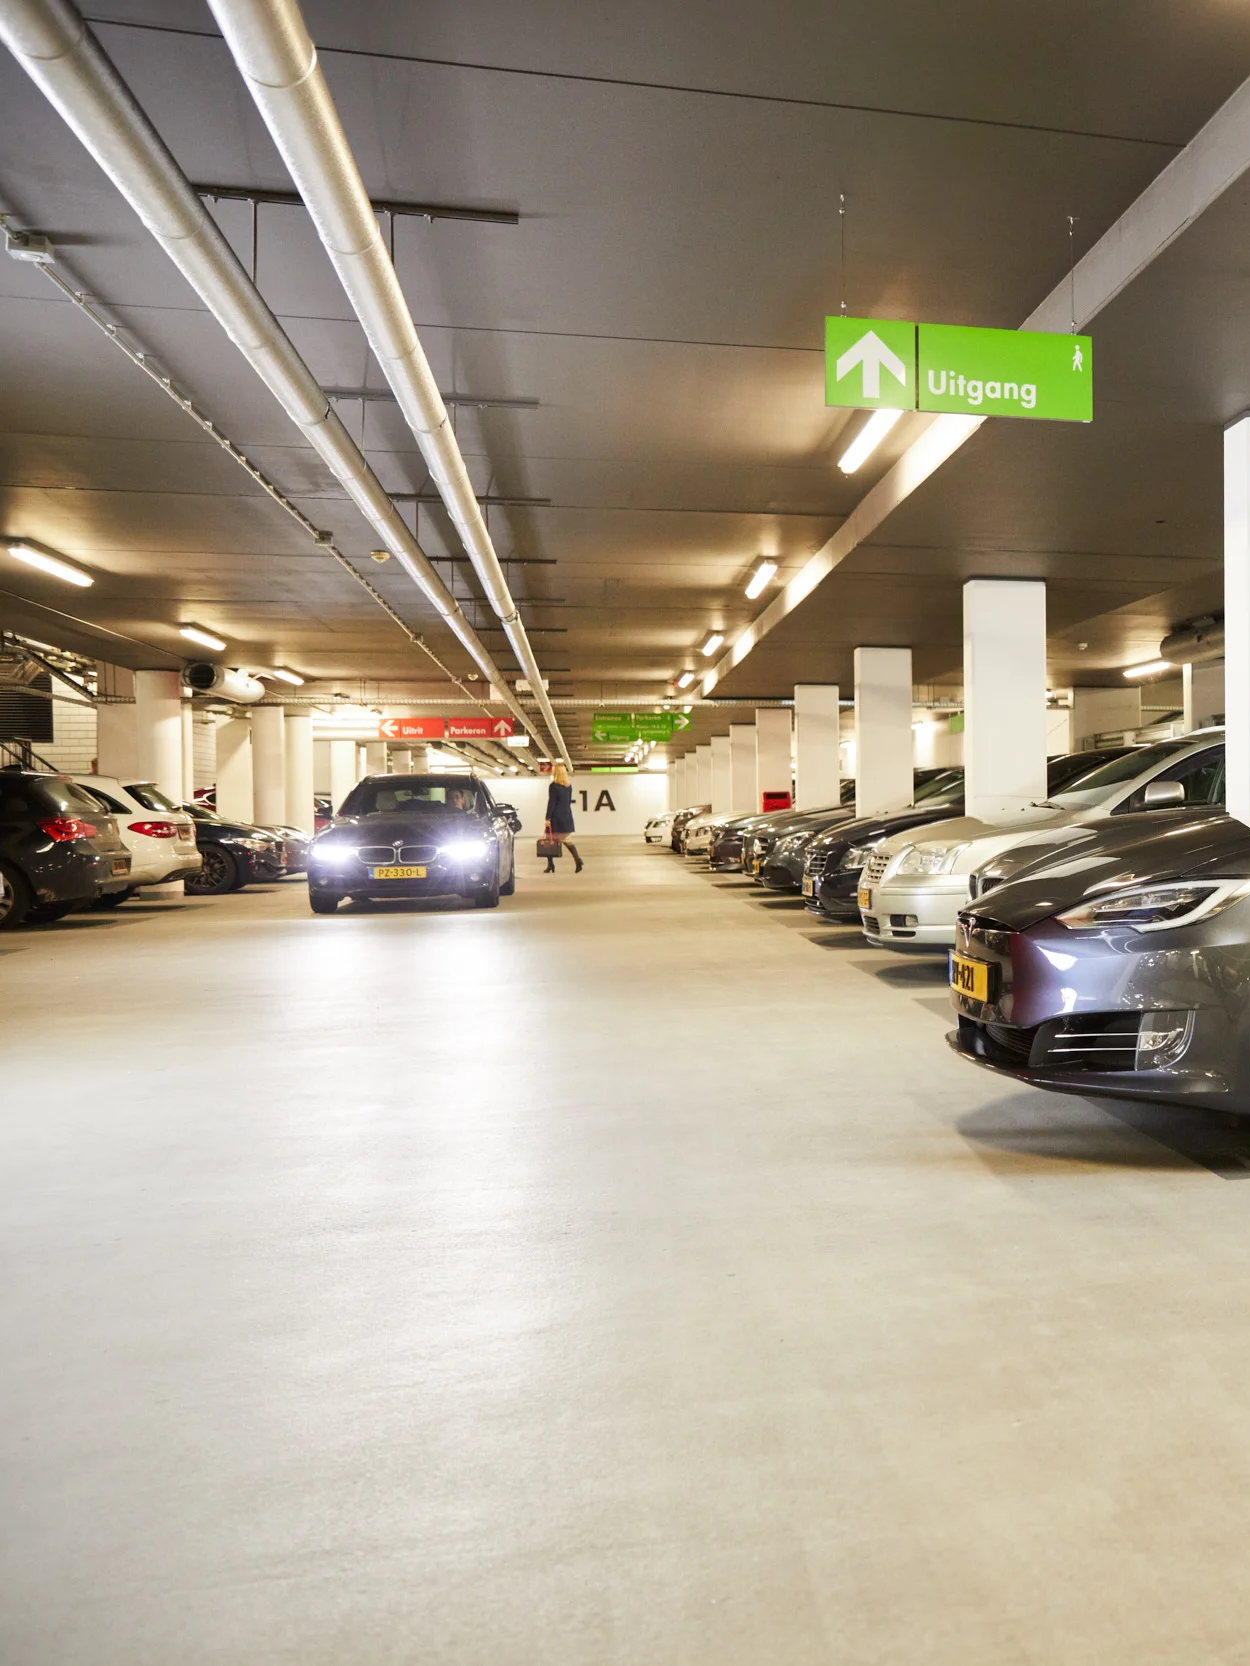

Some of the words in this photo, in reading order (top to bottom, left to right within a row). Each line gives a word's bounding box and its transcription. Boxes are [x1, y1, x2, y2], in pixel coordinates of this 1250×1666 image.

[928, 369, 1037, 409] Uitgang
[402, 725, 424, 735] Uitrit
[450, 725, 486, 735] Parkeren
[378, 867, 422, 878] PZ-330-L
